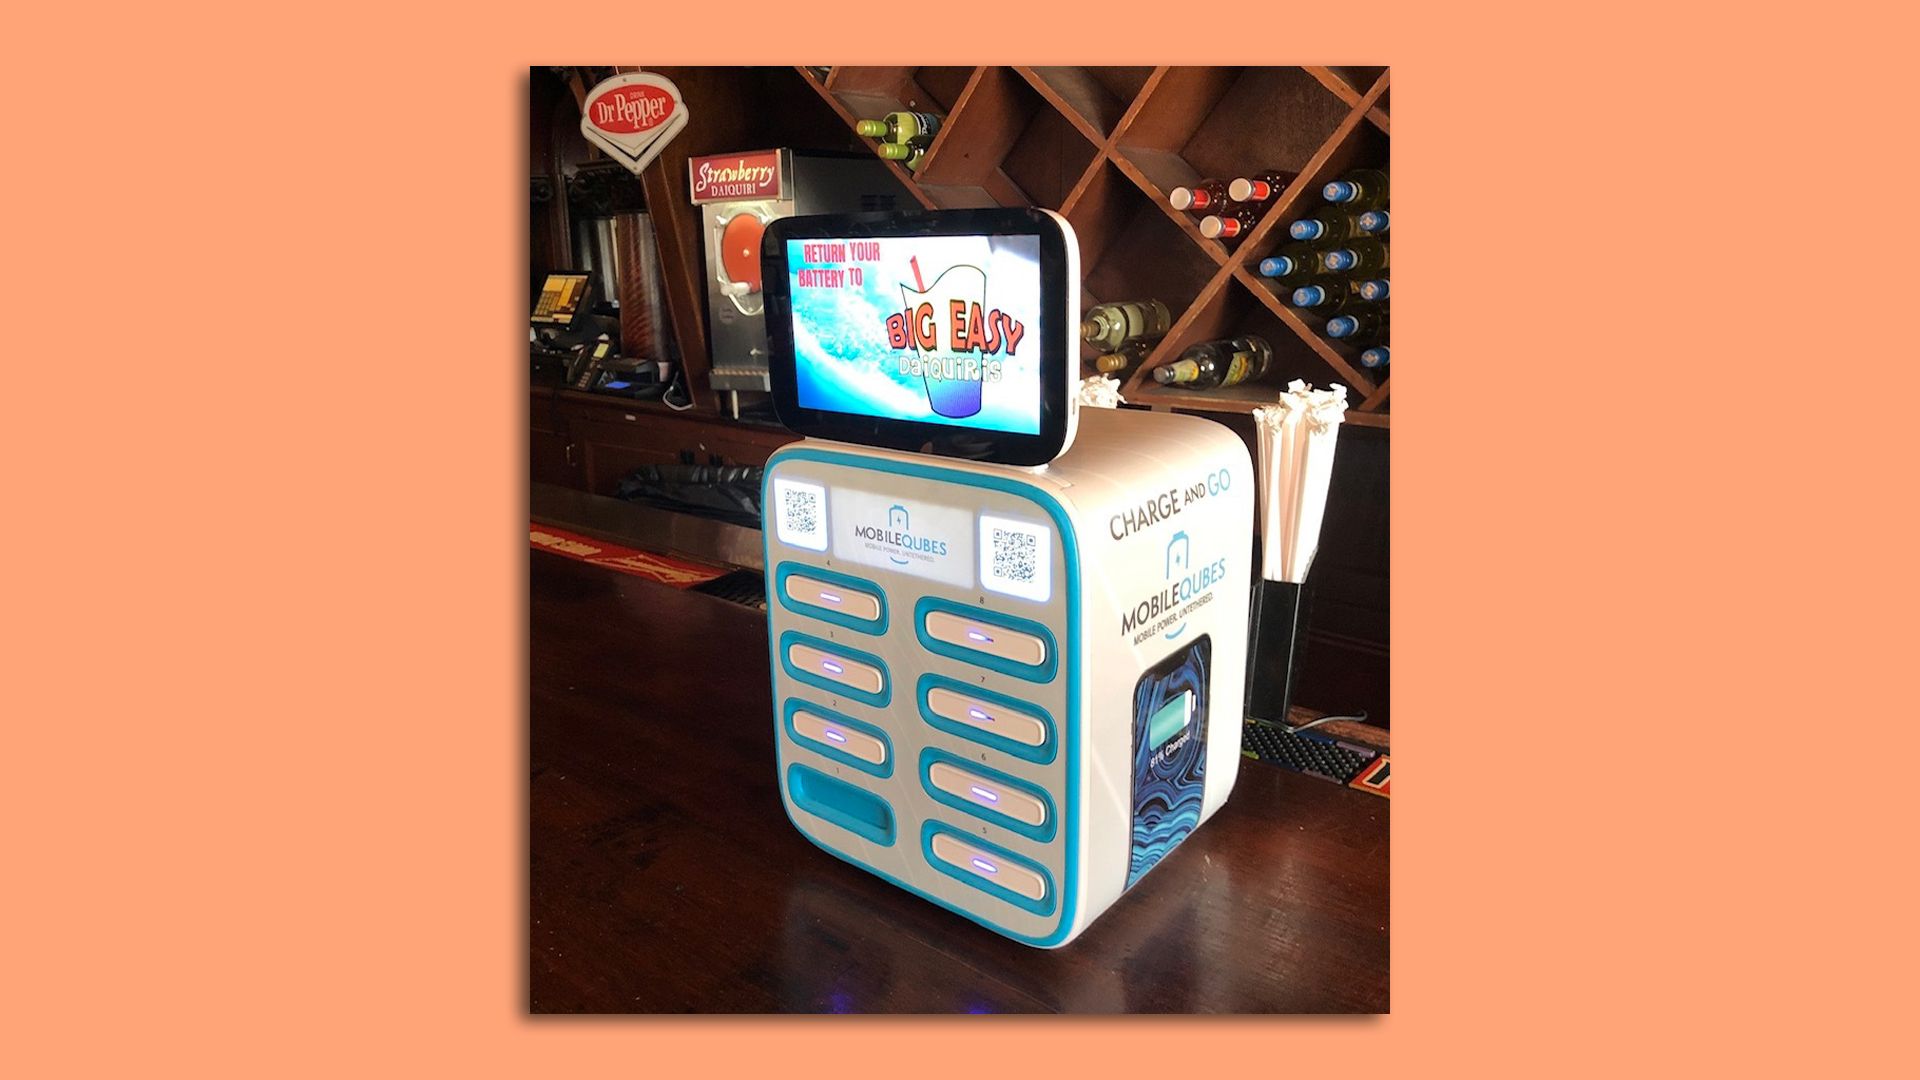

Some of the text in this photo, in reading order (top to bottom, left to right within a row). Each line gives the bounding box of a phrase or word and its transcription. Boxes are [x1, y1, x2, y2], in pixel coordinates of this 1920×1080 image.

[597, 93, 667, 130] Dr Pepper
[695, 160, 775, 192] Strawberry
[711, 183, 756, 197] DAIQUIRI
[804, 242, 881, 264] RETURN YOUR
[798, 268, 863, 288] BATTERY TO
[886, 299, 1025, 356] BIG EASY
[1109, 468, 1231, 541] CHARGE AND GO
[855, 525, 948, 556] MOBILEQUBES
[1121, 557, 1226, 637] MOBILEQUBES
[1133, 624, 1156, 646] MOBILE
